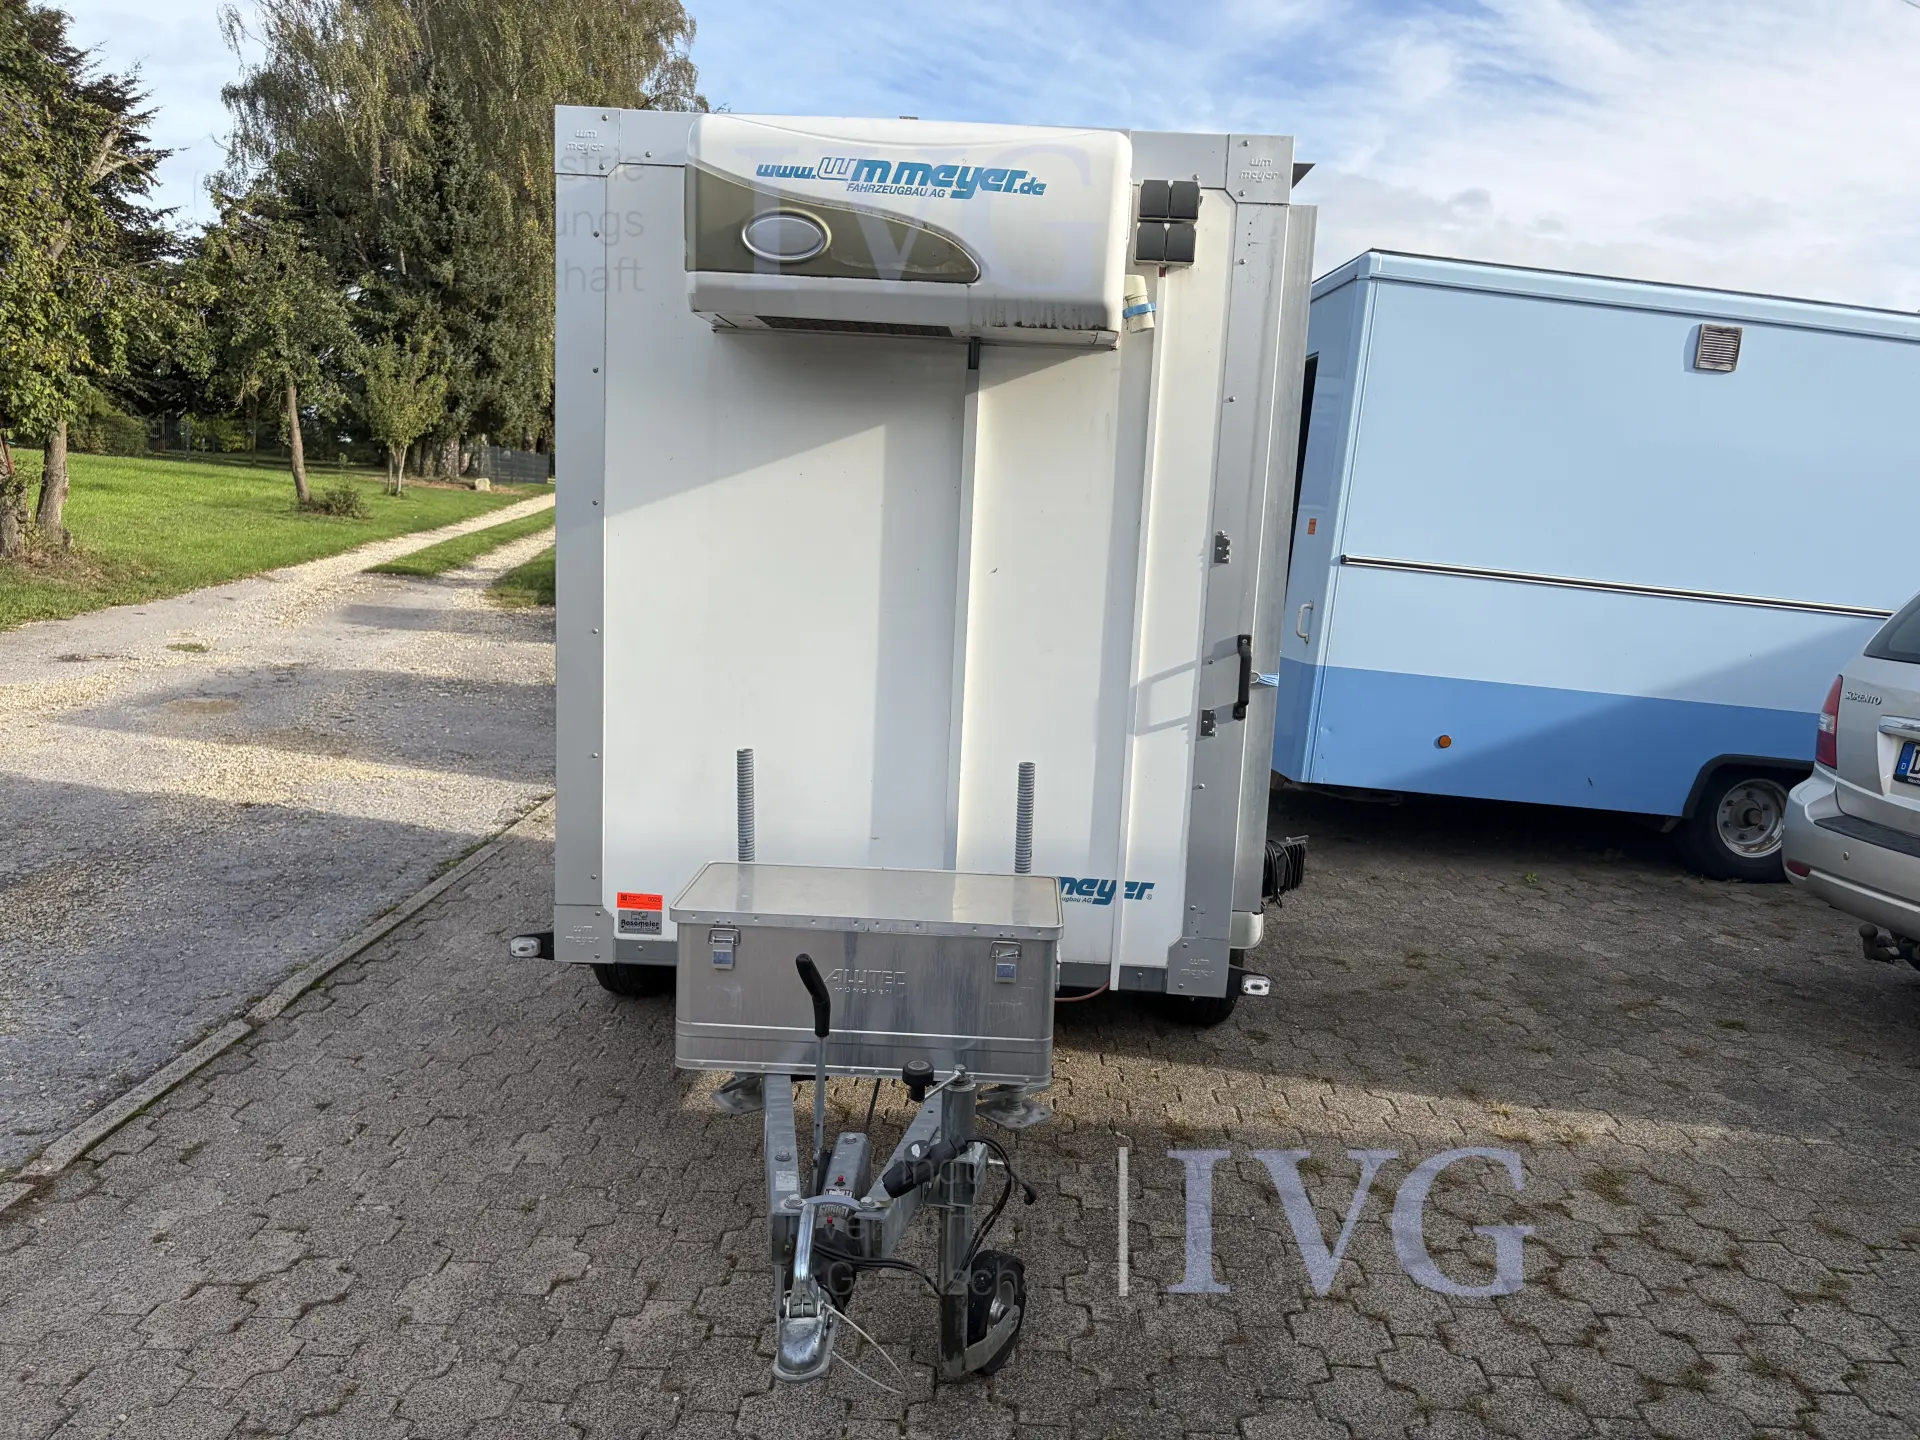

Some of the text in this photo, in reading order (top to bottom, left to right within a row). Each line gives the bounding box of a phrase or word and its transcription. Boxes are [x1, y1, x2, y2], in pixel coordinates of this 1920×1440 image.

[846, 183, 946, 198] FAHRZEUGBAU AG
[1845, 691, 1882, 705] SORENTO
